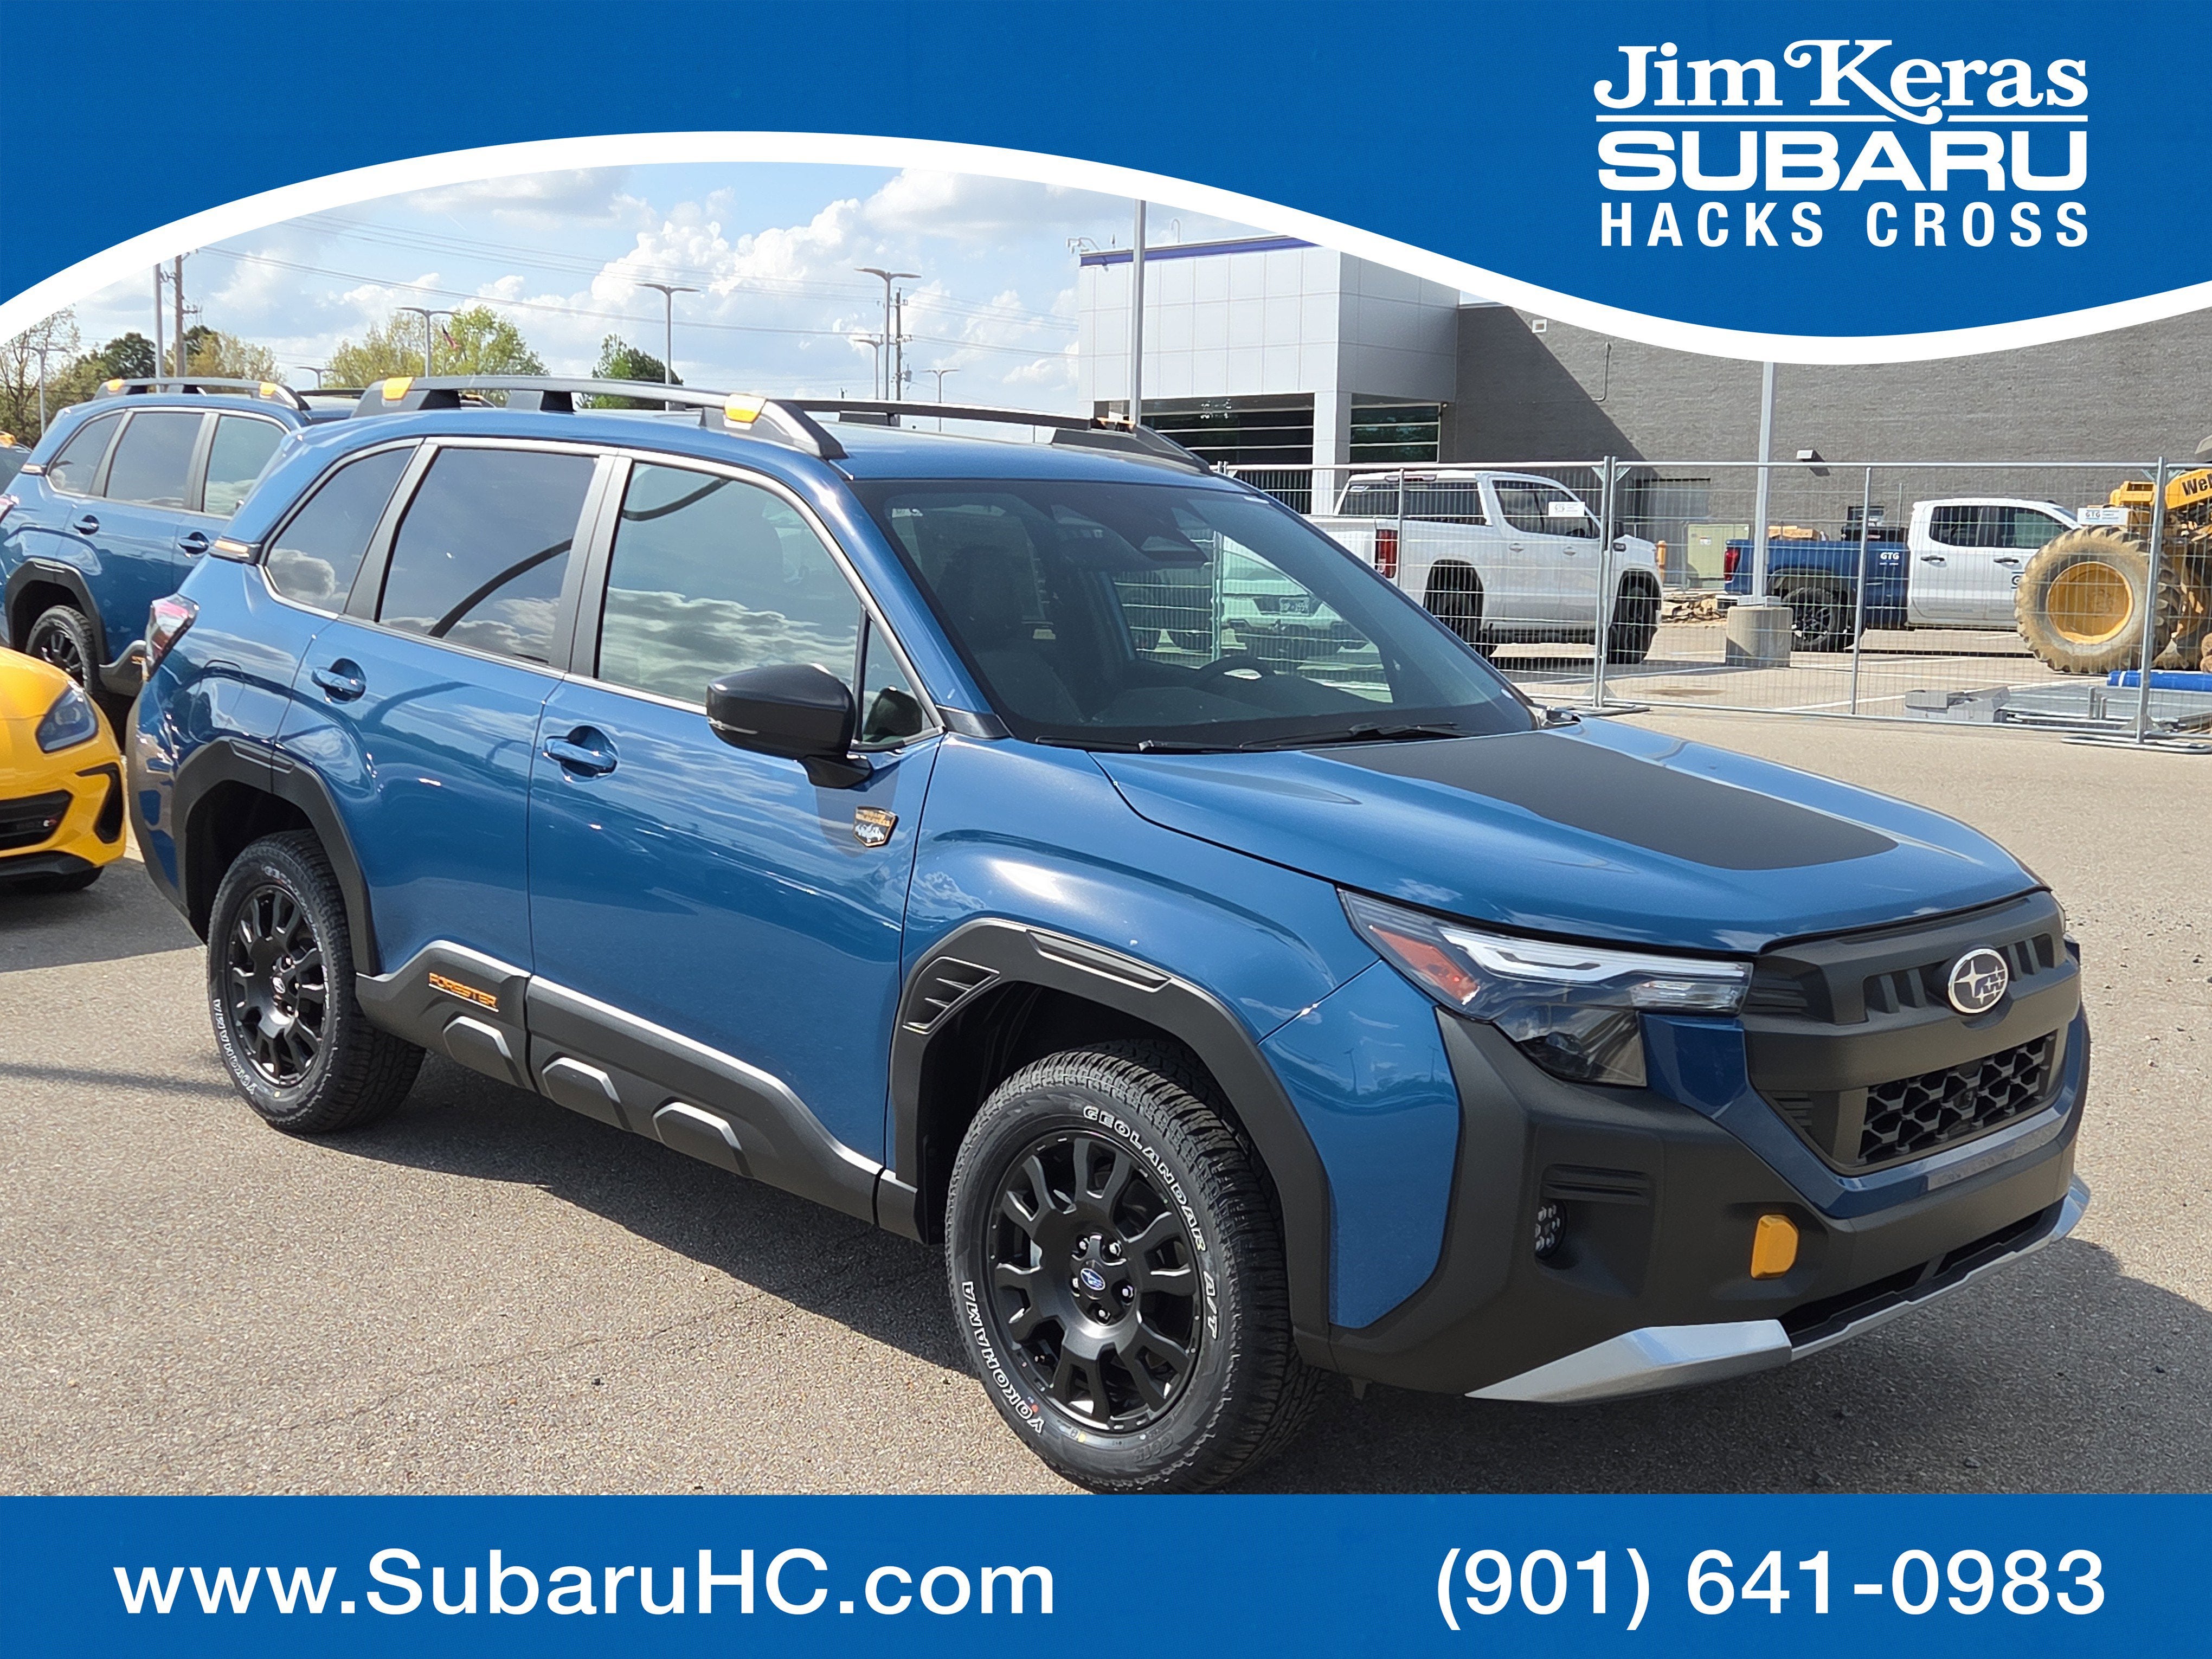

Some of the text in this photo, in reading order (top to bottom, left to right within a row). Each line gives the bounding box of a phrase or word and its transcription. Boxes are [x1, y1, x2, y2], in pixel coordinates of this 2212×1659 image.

[1880, 552, 1900, 560] GTG
[428, 972, 498, 1008] FORESTER
[1083, 1105, 1207, 1252] GEOLANDAR
[1203, 1270, 1218, 1340] A/T
[962, 1281, 1045, 1435] YOKOHAMA
